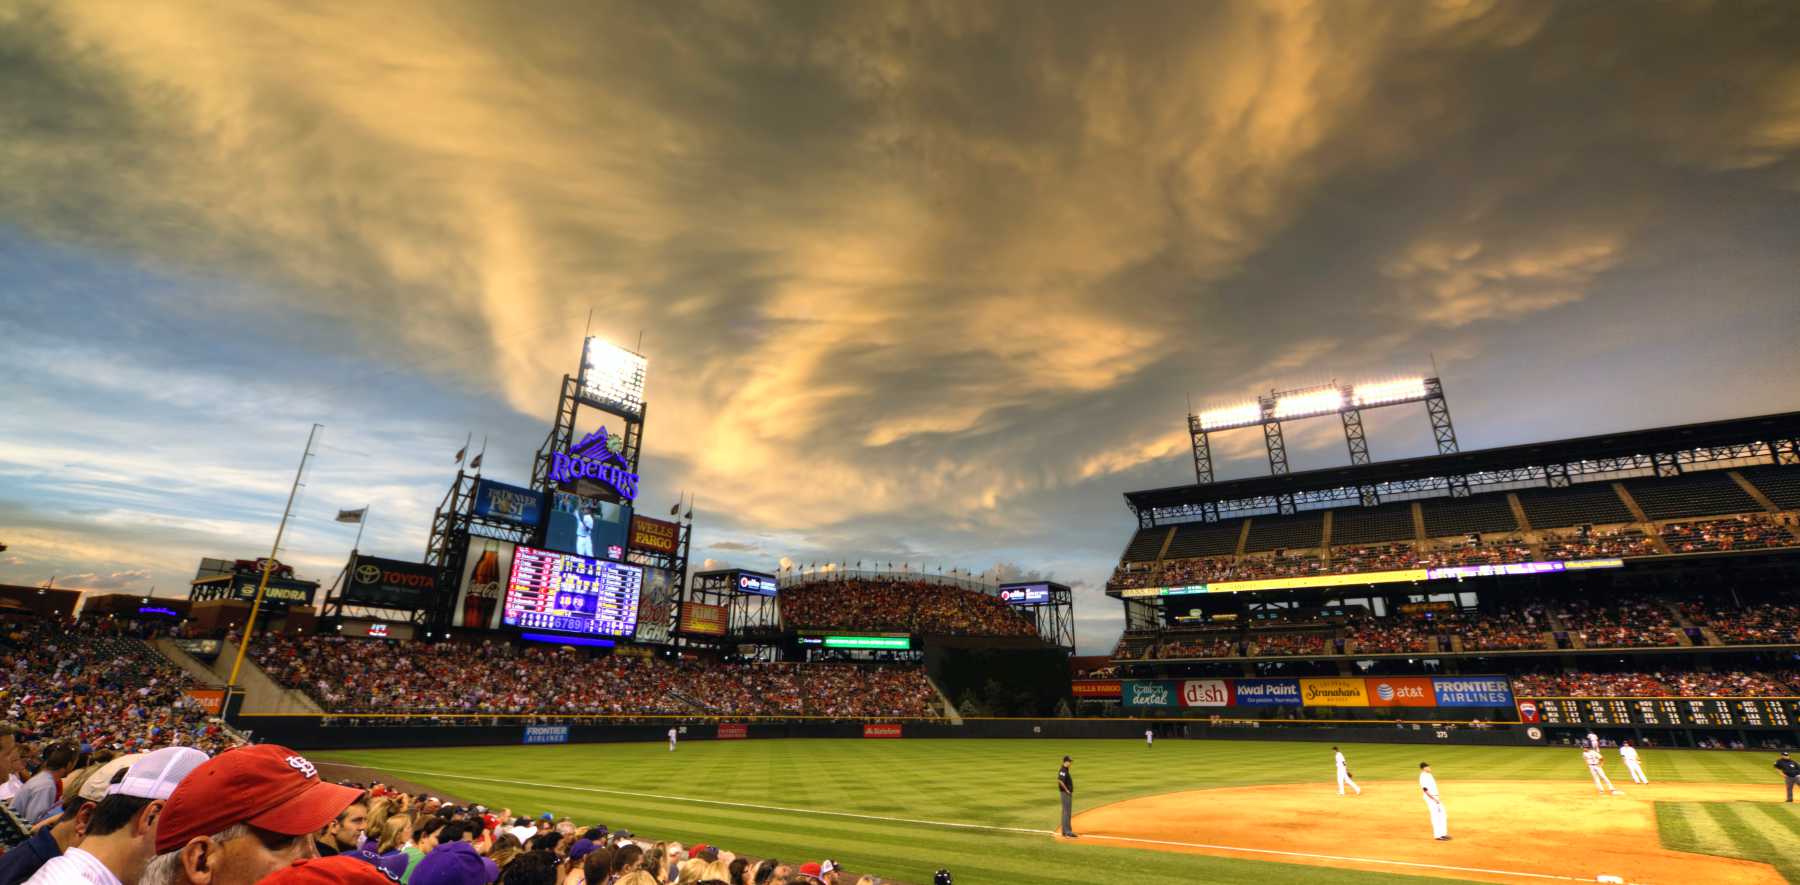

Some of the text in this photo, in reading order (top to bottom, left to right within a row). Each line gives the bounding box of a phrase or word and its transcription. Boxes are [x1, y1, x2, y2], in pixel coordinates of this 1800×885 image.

[549, 449, 640, 500] ROCKIES
[638, 521, 673, 538] WELLS
[635, 534, 672, 549] FARGO
[383, 570, 433, 587] TOYOTA
[1186, 684, 1225, 703] dish
[1237, 683, 1297, 696] Kwal Paint
[1306, 685, 1361, 700] Stranahan's
[1396, 686, 1424, 698] at&t
[1434, 681, 1509, 693] FRONTIER
[1132, 693, 1168, 704] dental
[1442, 692, 1506, 703] AIRLINES
